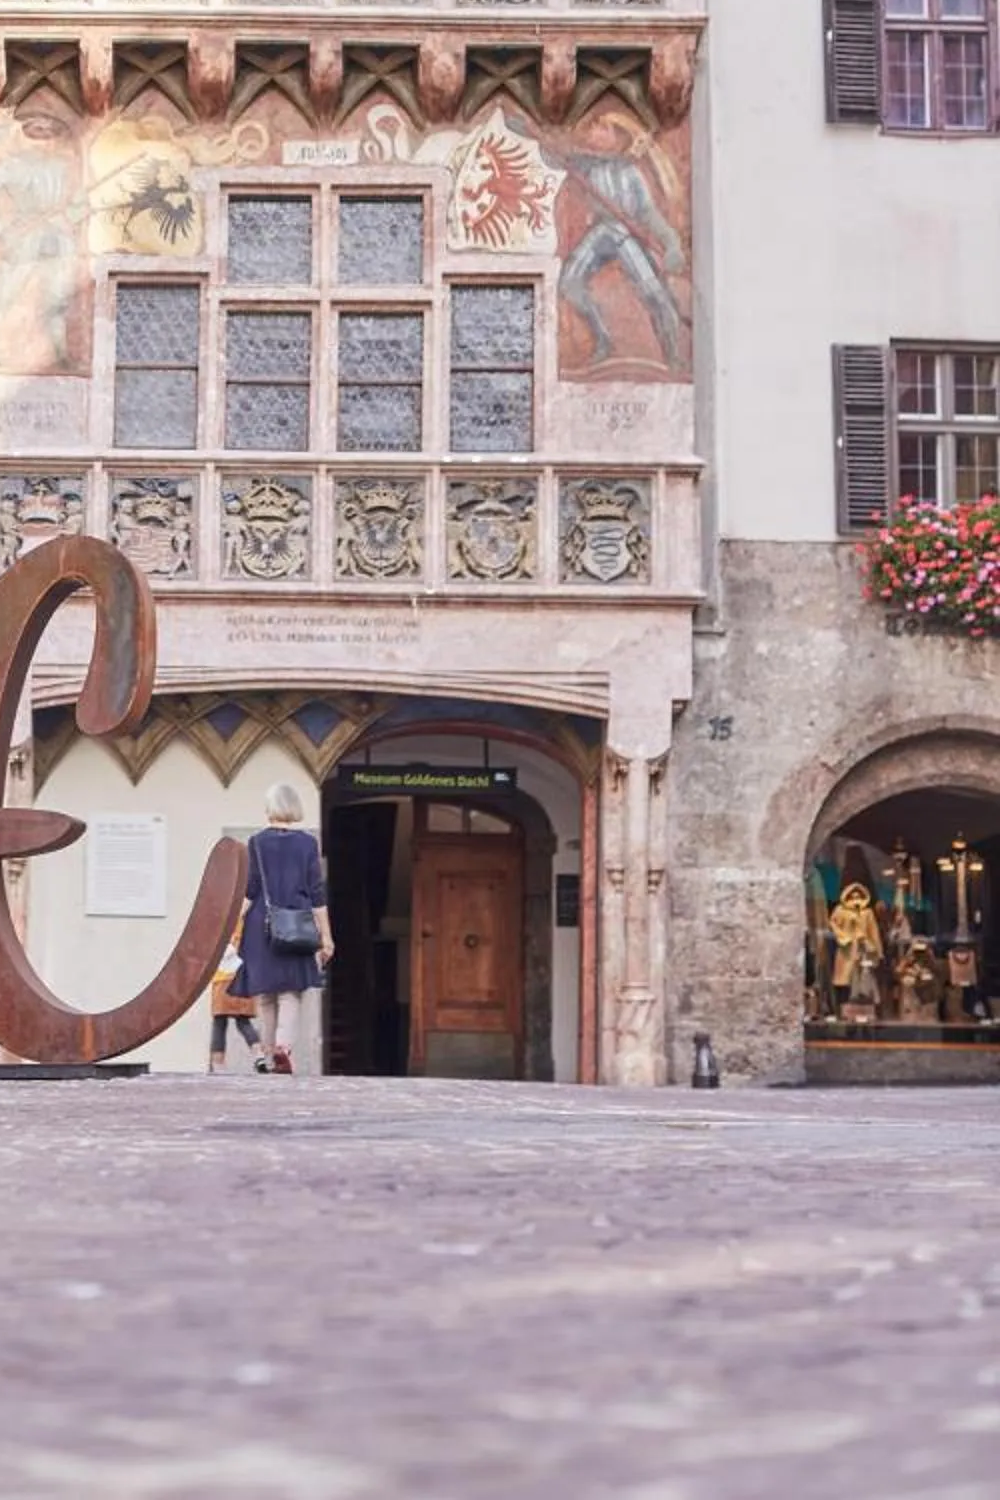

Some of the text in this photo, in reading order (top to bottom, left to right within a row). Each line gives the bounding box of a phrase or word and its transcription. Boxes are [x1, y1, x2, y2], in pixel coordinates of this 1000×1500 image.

[709, 716, 733, 741] 15
[353, 772, 402, 785] Museum
[403, 773, 455, 787] Goldenes
[457, 775, 489, 788] Dachl
